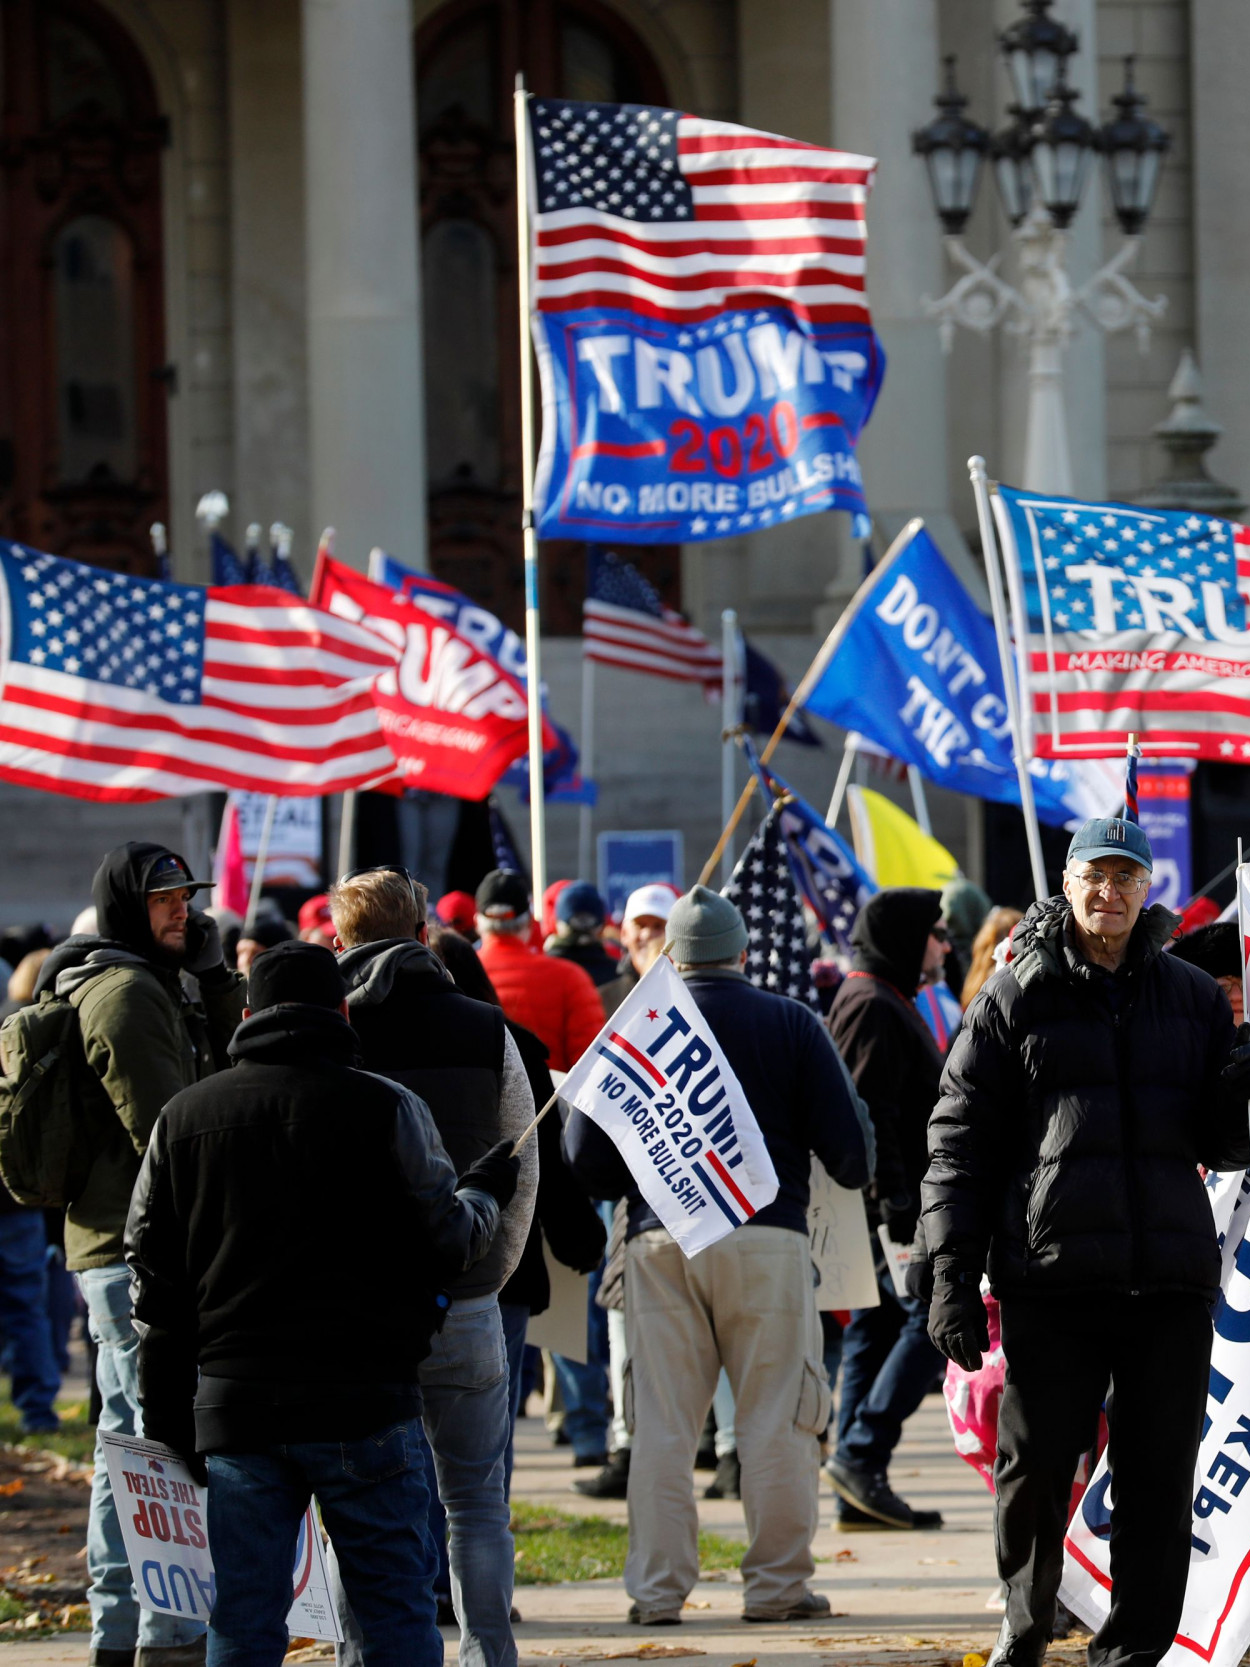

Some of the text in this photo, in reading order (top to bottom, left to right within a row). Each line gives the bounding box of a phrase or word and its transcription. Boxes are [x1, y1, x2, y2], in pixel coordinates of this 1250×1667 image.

[577, 323, 867, 418] TRUMP
[668, 400, 799, 477] 2020
[576, 452, 863, 515] NO MORE BULLSH
[1067, 652, 1167, 671] MAKING
[898, 675, 970, 768] THE
[597, 1072, 707, 1216] NO MORE BULLSHIT
[654, 1092, 703, 1159] 2020
[122, 1470, 201, 1507] THE STEAL
[132, 1498, 207, 1550] STOP
[141, 1560, 216, 1614] AUD
